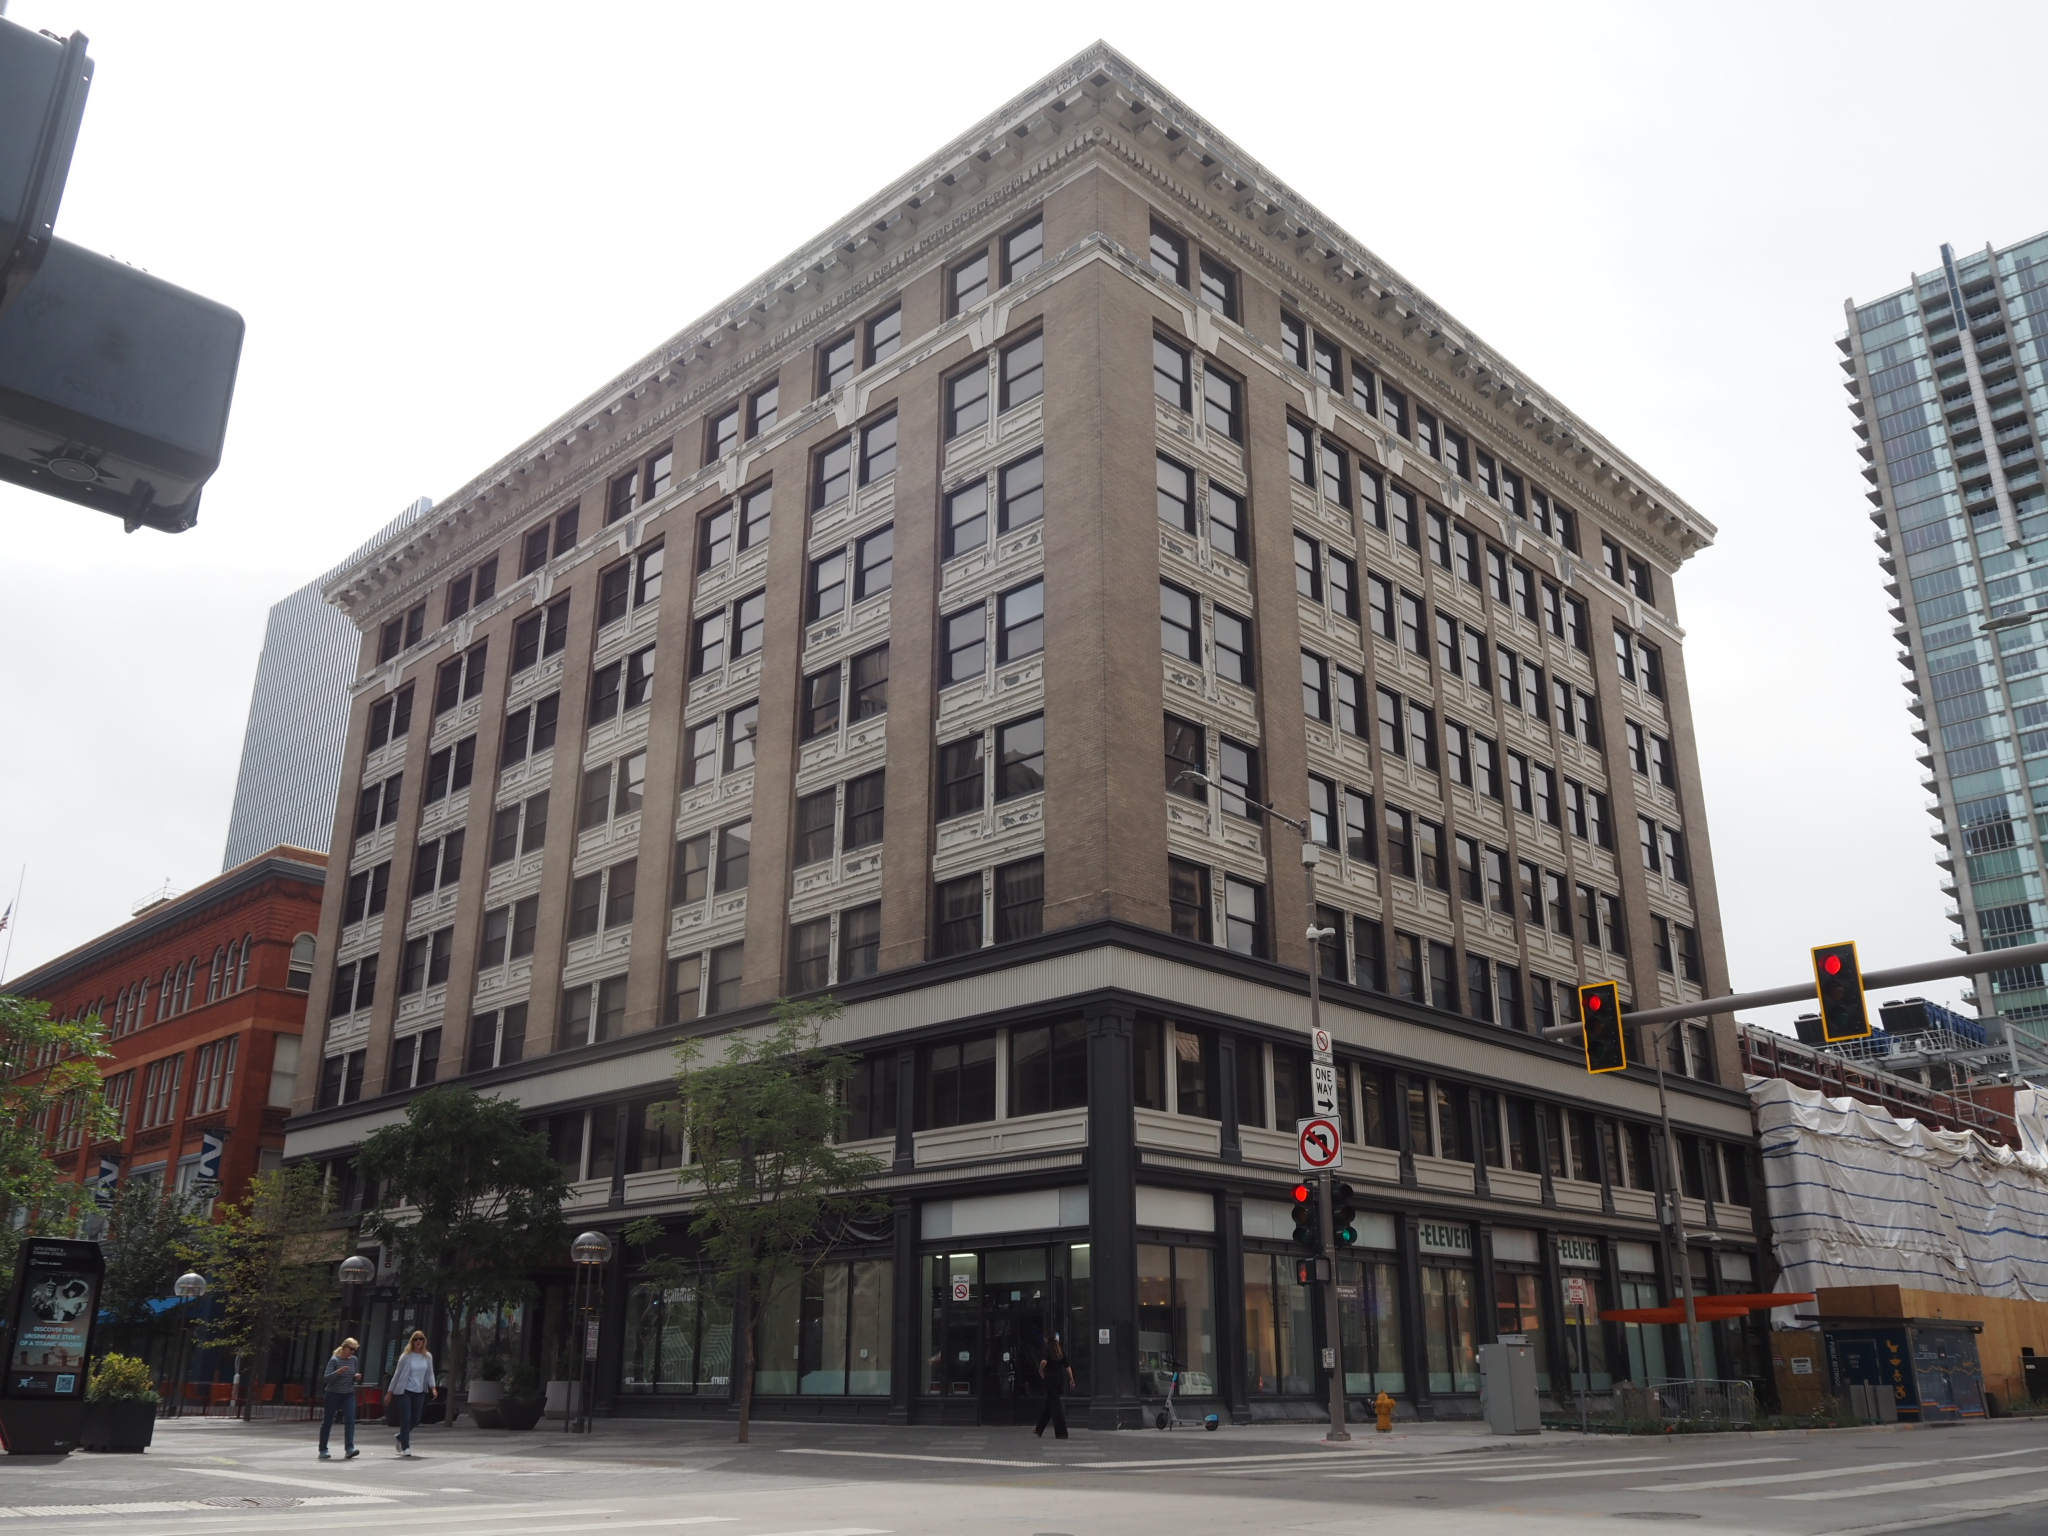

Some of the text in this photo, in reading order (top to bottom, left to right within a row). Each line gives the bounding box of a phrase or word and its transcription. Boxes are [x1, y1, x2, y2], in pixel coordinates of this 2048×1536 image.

[1315, 1068, 1332, 1082] ONE
[1316, 1082, 1333, 1096] WAY
[1829, 1341, 1838, 1360] PUBLIC
[710, 1376, 729, 1385] STREET
